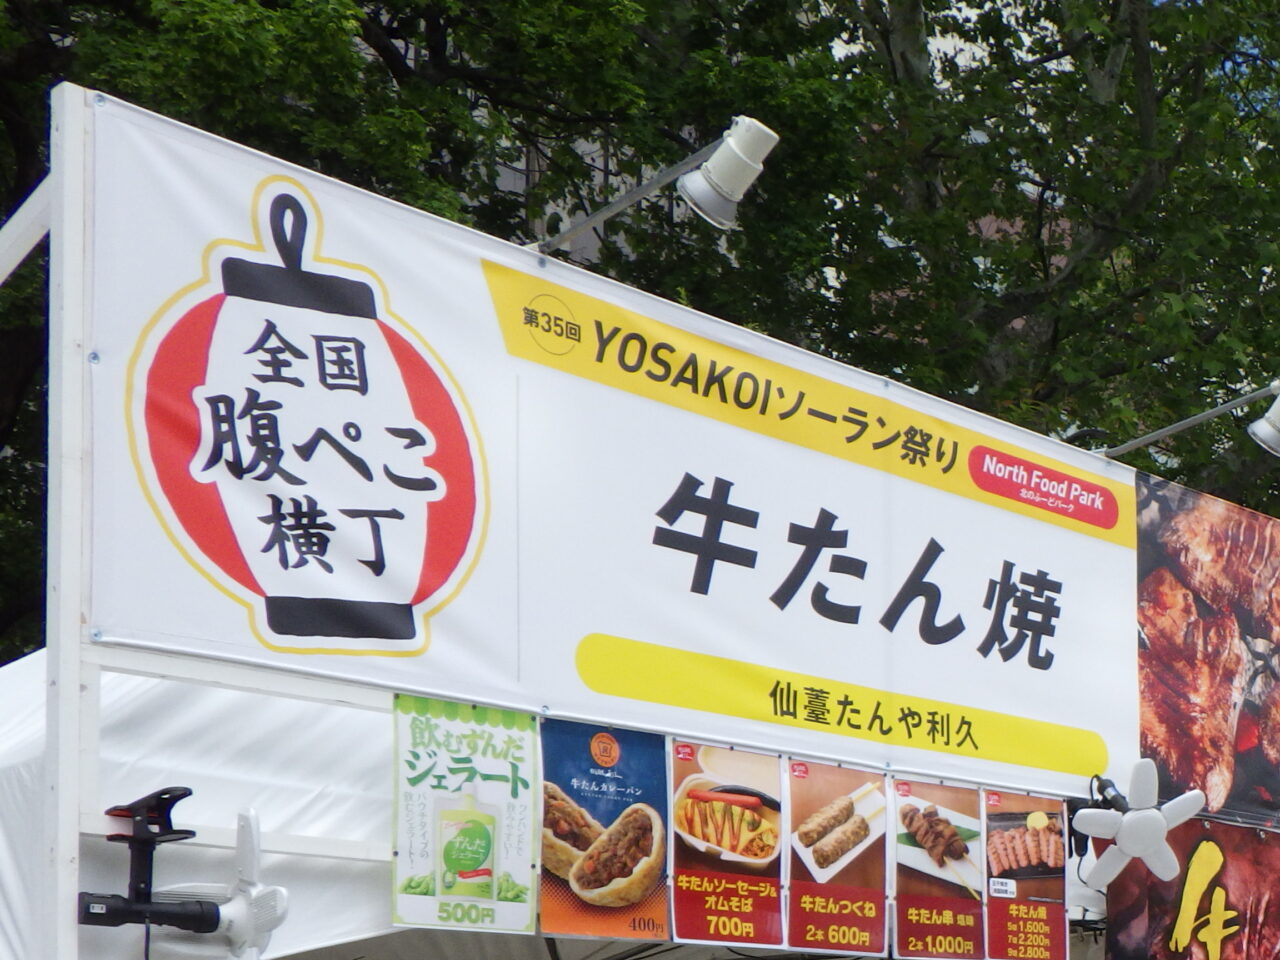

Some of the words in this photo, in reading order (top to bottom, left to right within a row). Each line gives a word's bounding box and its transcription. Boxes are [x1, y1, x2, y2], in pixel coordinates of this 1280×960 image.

[244, 319, 367, 396] 全国
[522, 306, 582, 345] 第35回
[593, 320, 959, 474] YOSAKOIソーラン祭り
[201, 388, 440, 492] 腹ぺこ
[983, 454, 1028, 485] North
[1030, 470, 1068, 498] Food
[1069, 483, 1105, 510] Park
[257, 494, 405, 576] 横丁
[652, 472, 1063, 671] 牛たん焼
[409, 716, 526, 762] 飲むずんだ
[404, 750, 530, 799] ジェラート
[570, 777, 643, 796] 牛たんカレーパン
[677, 875, 777, 897] 牛たんソーセージ&
[438, 901, 495, 924] 500円
[705, 895, 753, 912] オムそば
[800, 895, 877, 918] 牛たんつくね
[628, 917, 664, 932] 400円
[706, 916, 754, 937] 700円
[908, 907, 953, 925] 牛たん串
[806, 925, 824, 940] 2本
[828, 925, 870, 946] 600円
[908, 937, 923, 950] 2本
[926, 935, 973, 955] 1,000円
